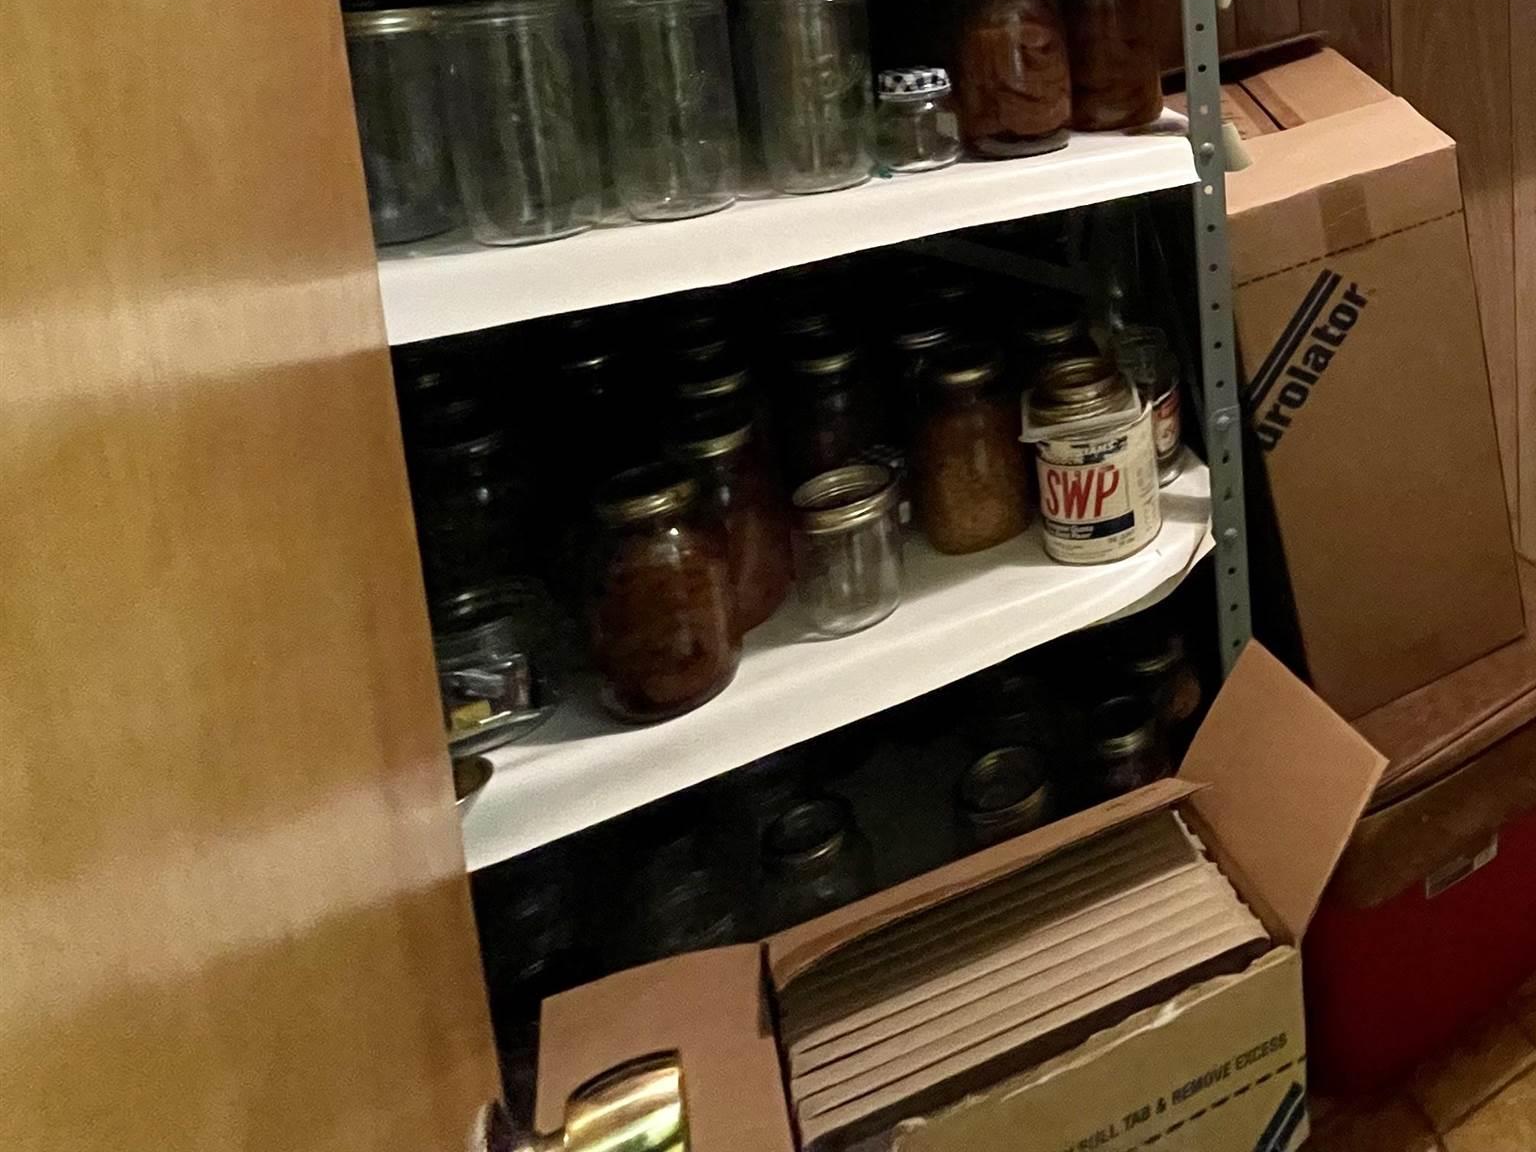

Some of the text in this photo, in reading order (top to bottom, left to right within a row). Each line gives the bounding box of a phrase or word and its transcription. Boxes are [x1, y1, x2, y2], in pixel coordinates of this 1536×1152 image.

[1255, 282, 1368, 453] urolator
[1046, 464, 1120, 519] SWP
[1122, 1105, 1151, 1132] TAB
[1155, 1097, 1167, 1115] &
[1171, 1059, 1233, 1105] REMOVE
[1234, 1032, 1288, 1071] EXCESS
